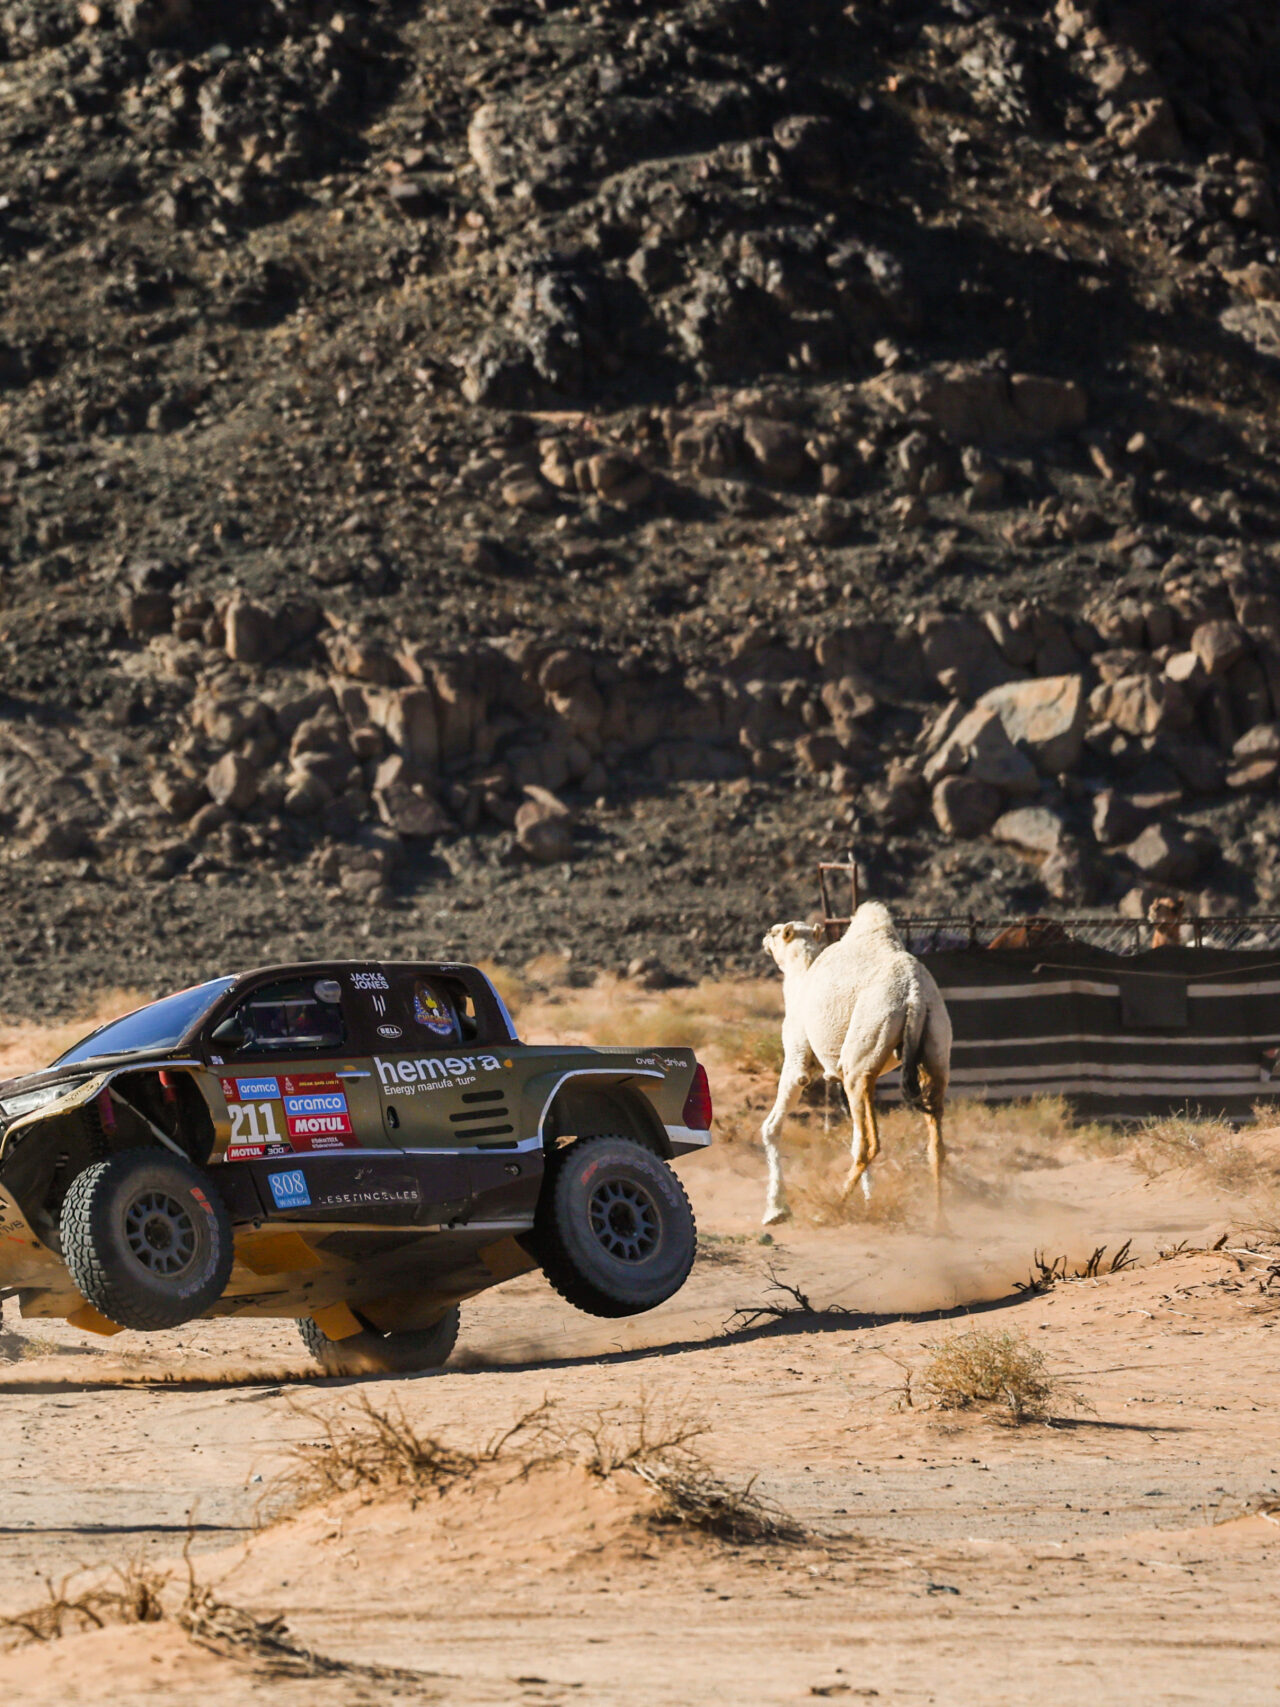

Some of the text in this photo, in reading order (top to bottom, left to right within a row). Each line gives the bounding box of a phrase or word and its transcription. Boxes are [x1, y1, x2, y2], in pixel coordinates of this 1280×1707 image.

[350, 972, 385, 981] JACK&
[354, 980, 389, 990] JONES
[373, 1055, 501, 1084] hemera
[240, 1083, 277, 1093] aramco
[383, 1076, 476, 1096] Energy manufature
[289, 1097, 342, 1111] aramco
[227, 1103, 282, 1144] 211
[295, 1117, 345, 1133] MOTUL
[231, 1147, 262, 1158] MOTUL
[271, 1172, 304, 1196] 808
